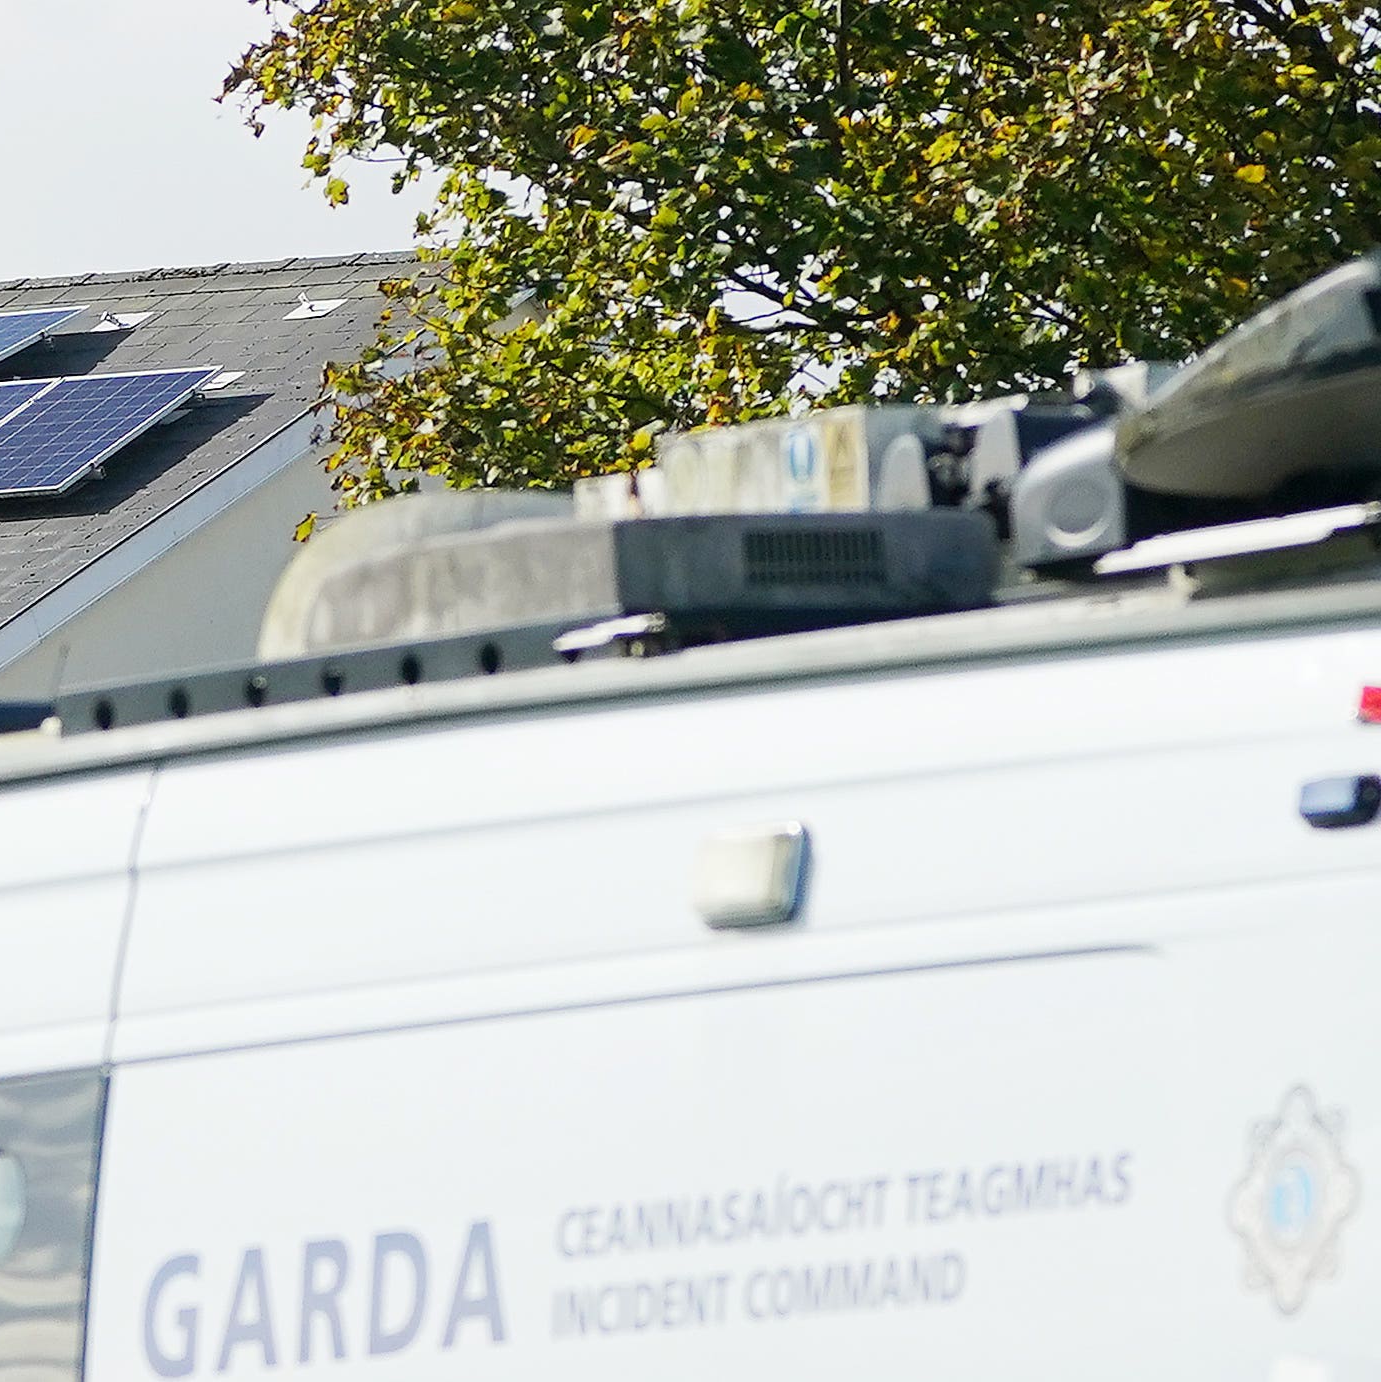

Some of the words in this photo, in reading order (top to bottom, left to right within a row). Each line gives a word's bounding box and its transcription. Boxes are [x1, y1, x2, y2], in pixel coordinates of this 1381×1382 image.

[556, 1172, 890, 1257] CEANNASAÍOCHT
[905, 1151, 1133, 1222] TEAGMHAS
[143, 1221, 506, 1378] GARDA
[551, 1272, 731, 1340] INCIDENT
[745, 1251, 967, 1319] COMMAND
